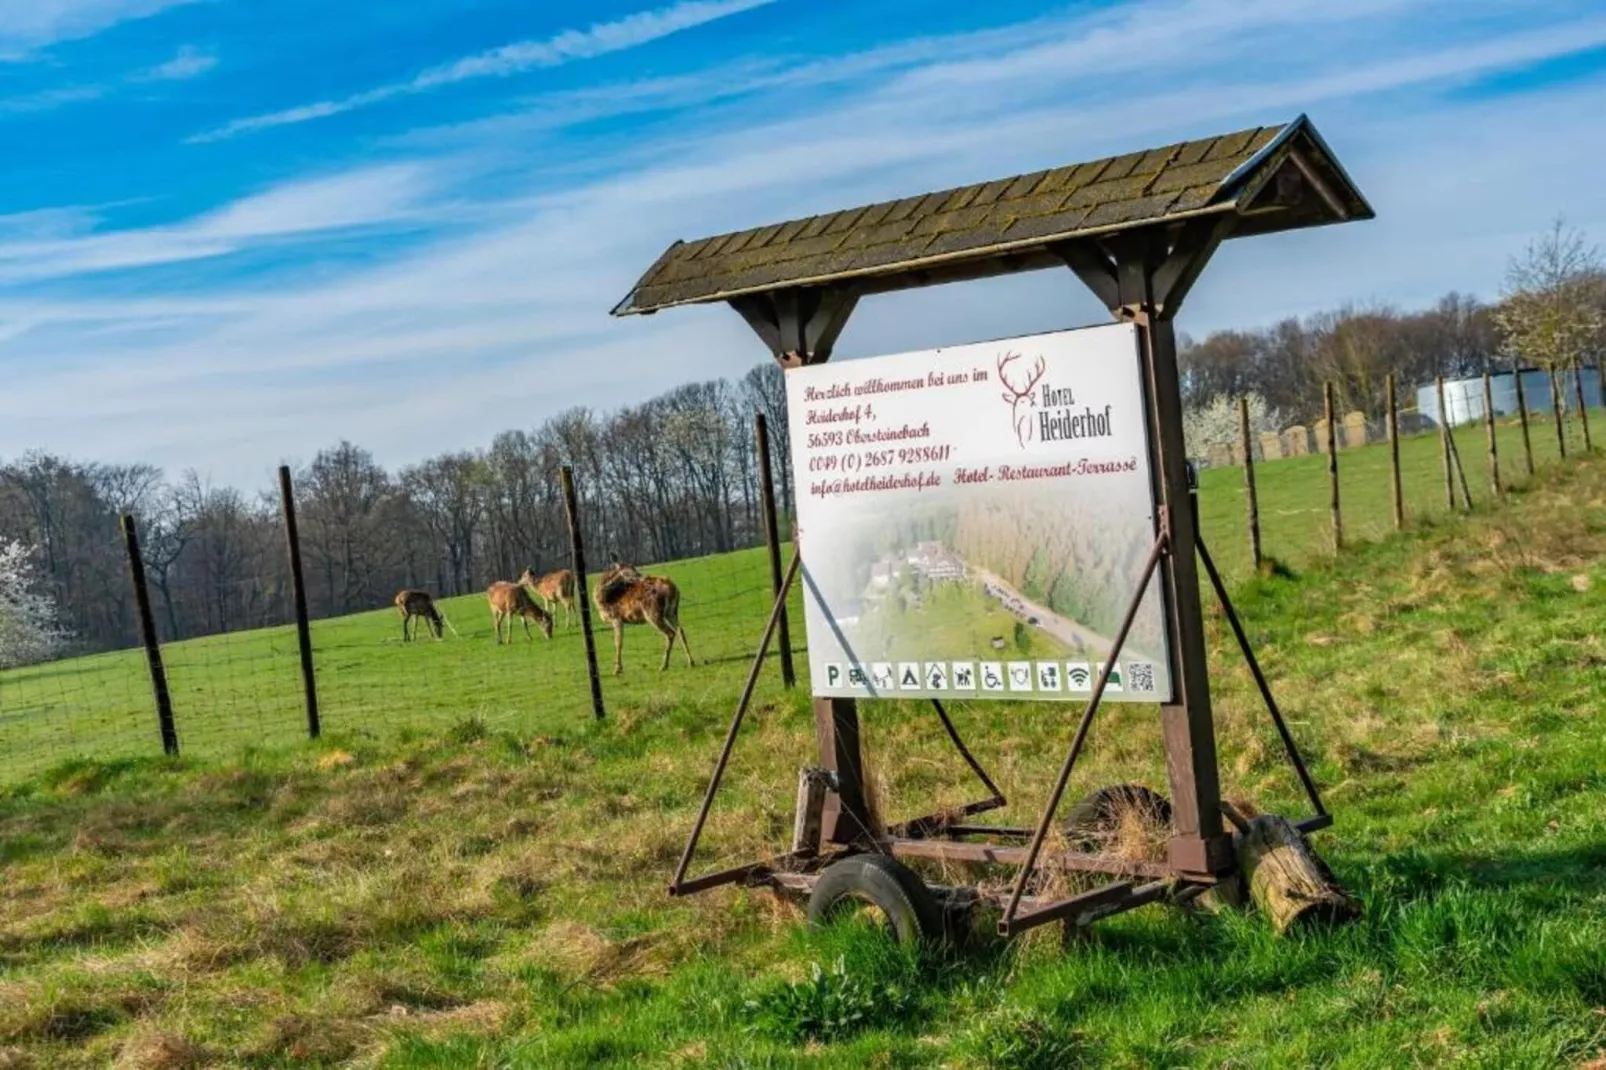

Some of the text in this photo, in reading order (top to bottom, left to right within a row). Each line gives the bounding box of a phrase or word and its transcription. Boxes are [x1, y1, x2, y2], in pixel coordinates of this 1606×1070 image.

[804, 367, 988, 402] Herzlich willkommen bei uns im
[806, 405, 861, 425] Heiderhof
[1039, 404, 1112, 441] Heiderhof
[807, 430, 843, 448] 56593
[809, 445, 950, 472] 0049 (0) 2687 9288611
[811, 471, 941, 499] info@hotelheiderhof.de
